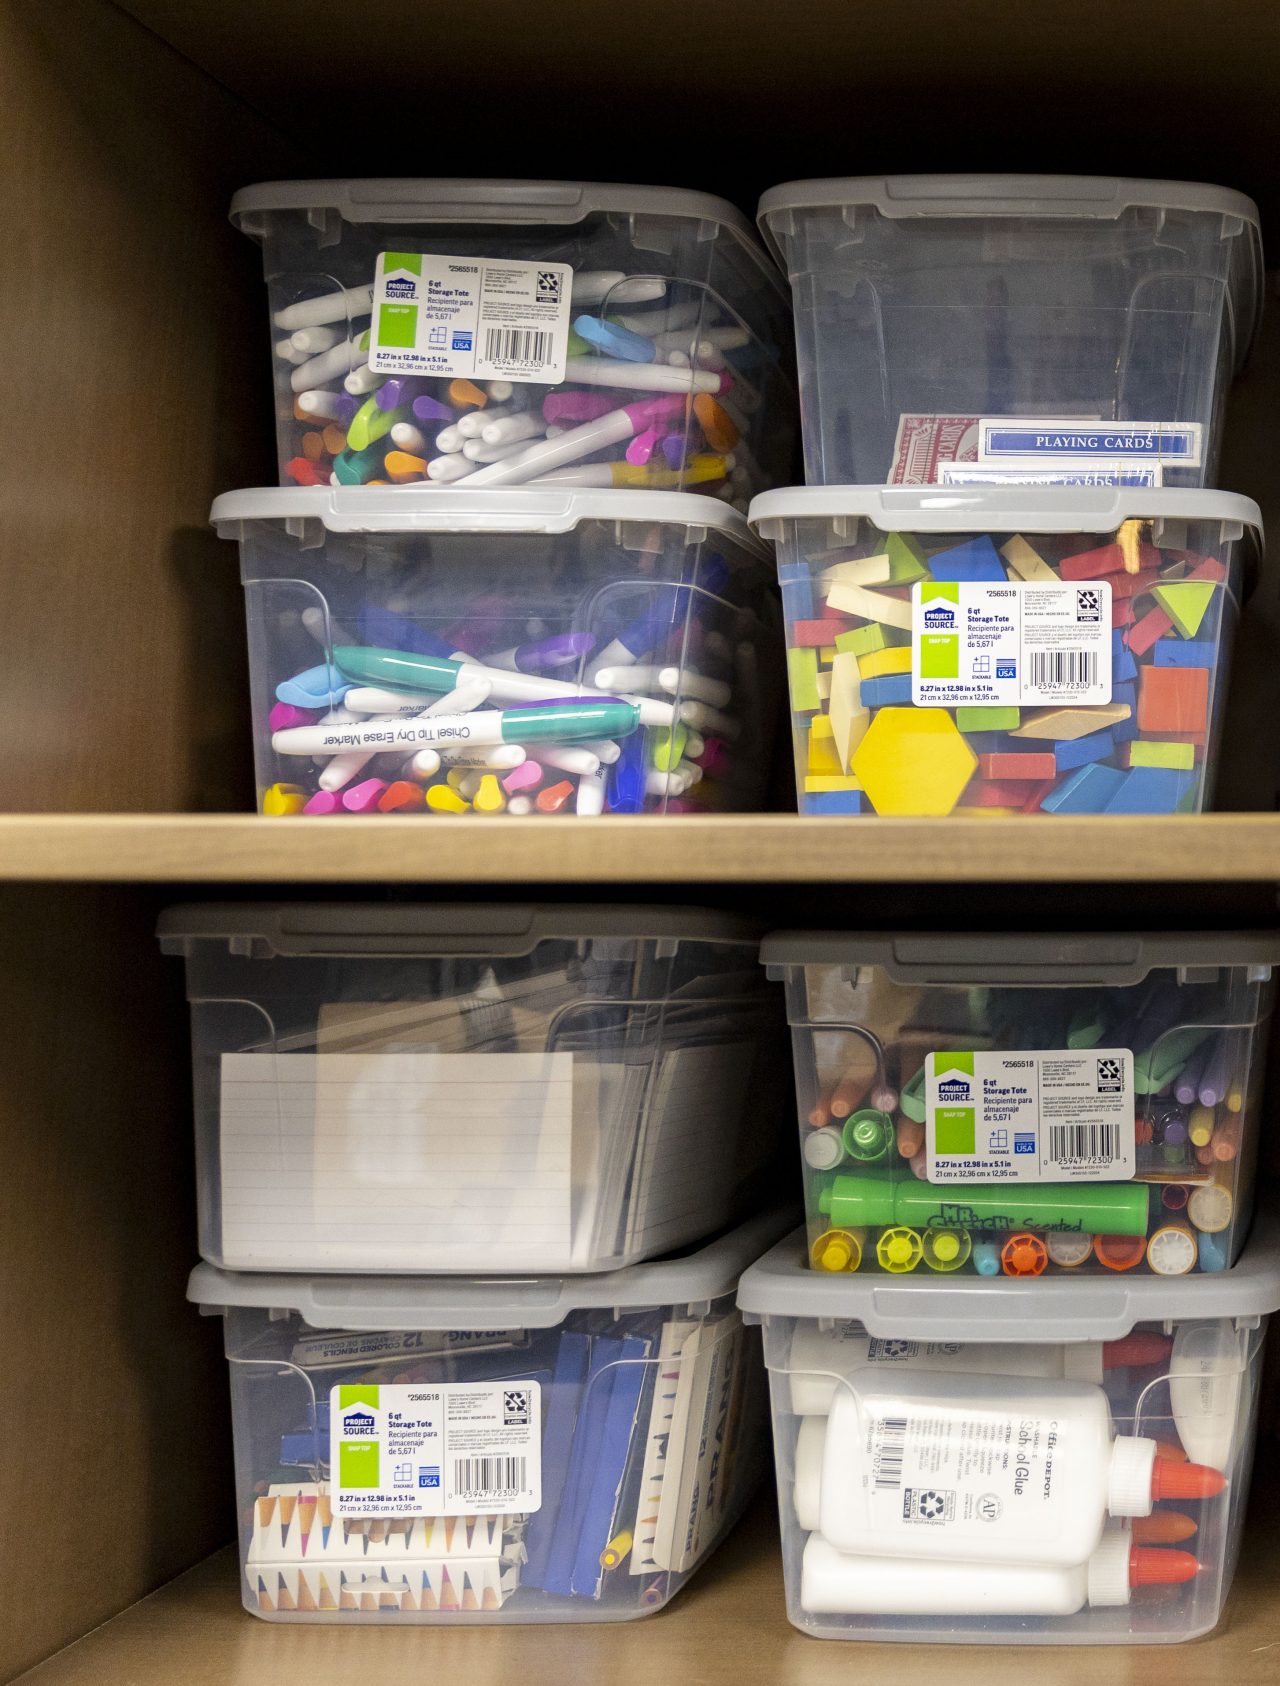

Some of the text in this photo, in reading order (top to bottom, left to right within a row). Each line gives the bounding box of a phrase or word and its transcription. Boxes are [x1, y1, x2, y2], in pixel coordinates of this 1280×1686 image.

[1035, 436, 1154, 449] PLAYING CARDS
[323, 726, 471, 745] Chisel Tip Dry Erase Marker
[983, 1087, 1010, 1096] Storage
[983, 1097, 1017, 1105] Recipiente
[983, 1105, 1019, 1113] almacenaje
[345, 1418, 372, 1426] PROJECT
[388, 1420, 433, 1429] Storage Tote
[388, 1430, 422, 1438] Recipiente
[388, 1439, 424, 1447] almacenaje
[1014, 1467, 1030, 1496] Glue
